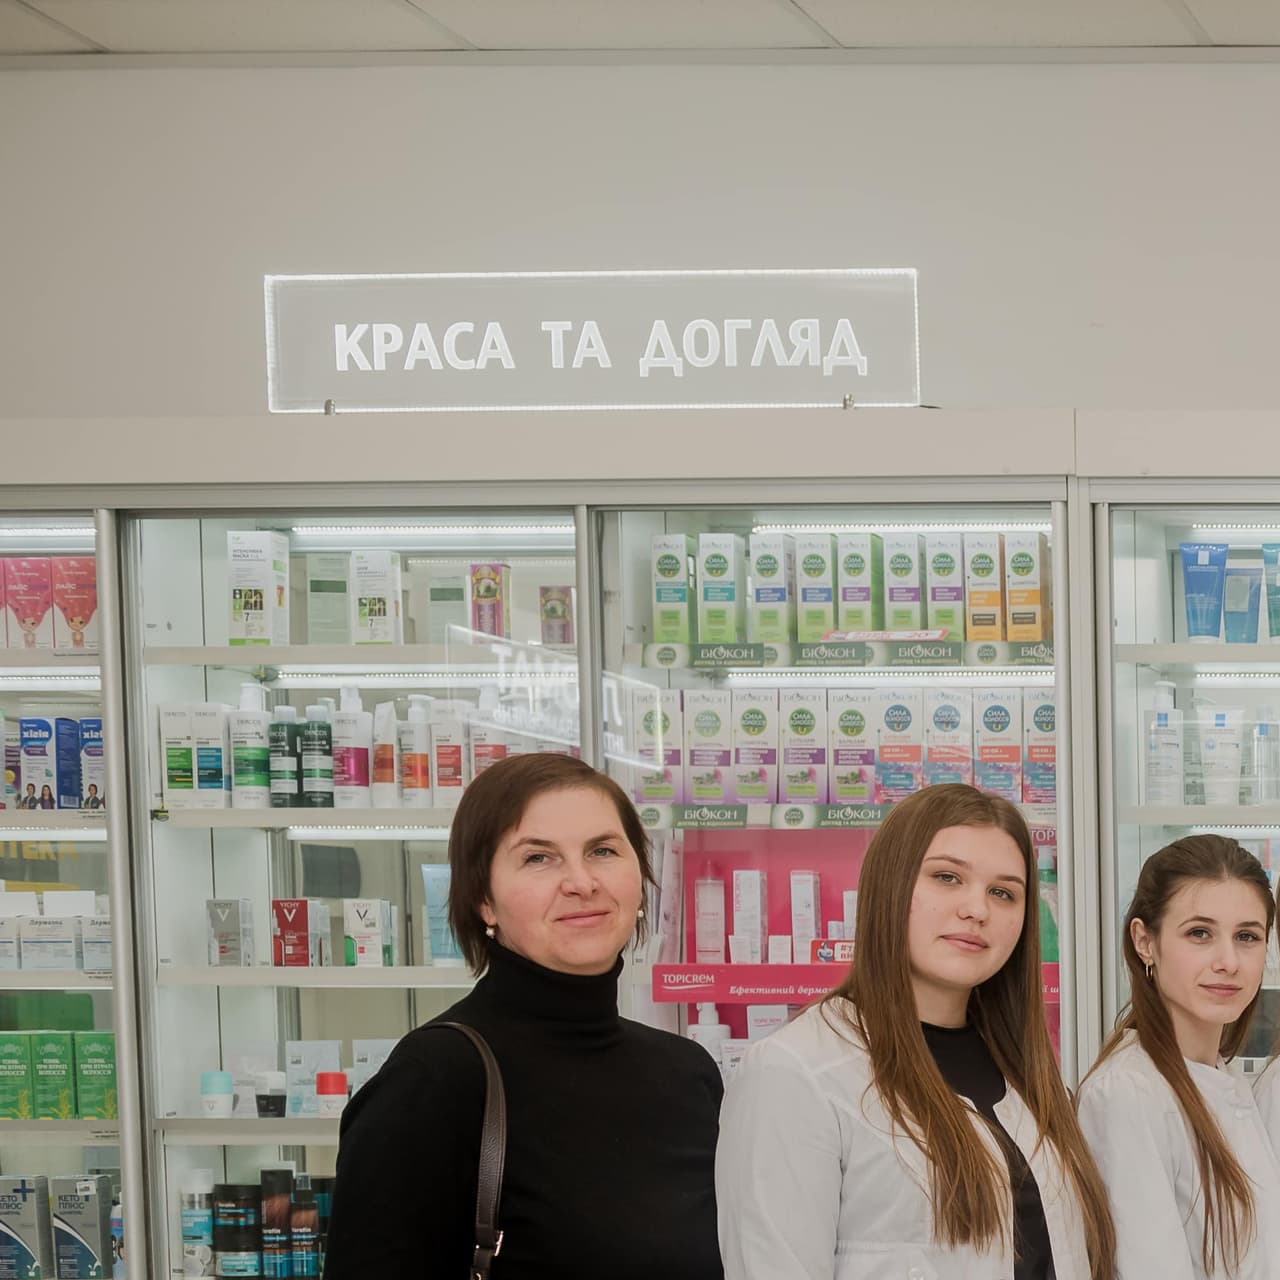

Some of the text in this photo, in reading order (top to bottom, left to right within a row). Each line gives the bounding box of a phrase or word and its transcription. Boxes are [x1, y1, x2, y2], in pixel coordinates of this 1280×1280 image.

[334, 318, 868, 377] КРАСА ТА ДОГЛЯД
[662, 974, 715, 984] TOPICREM
[729, 986, 795, 995] Ефективний
[58, 1202, 85, 1210] ПЛЮС
